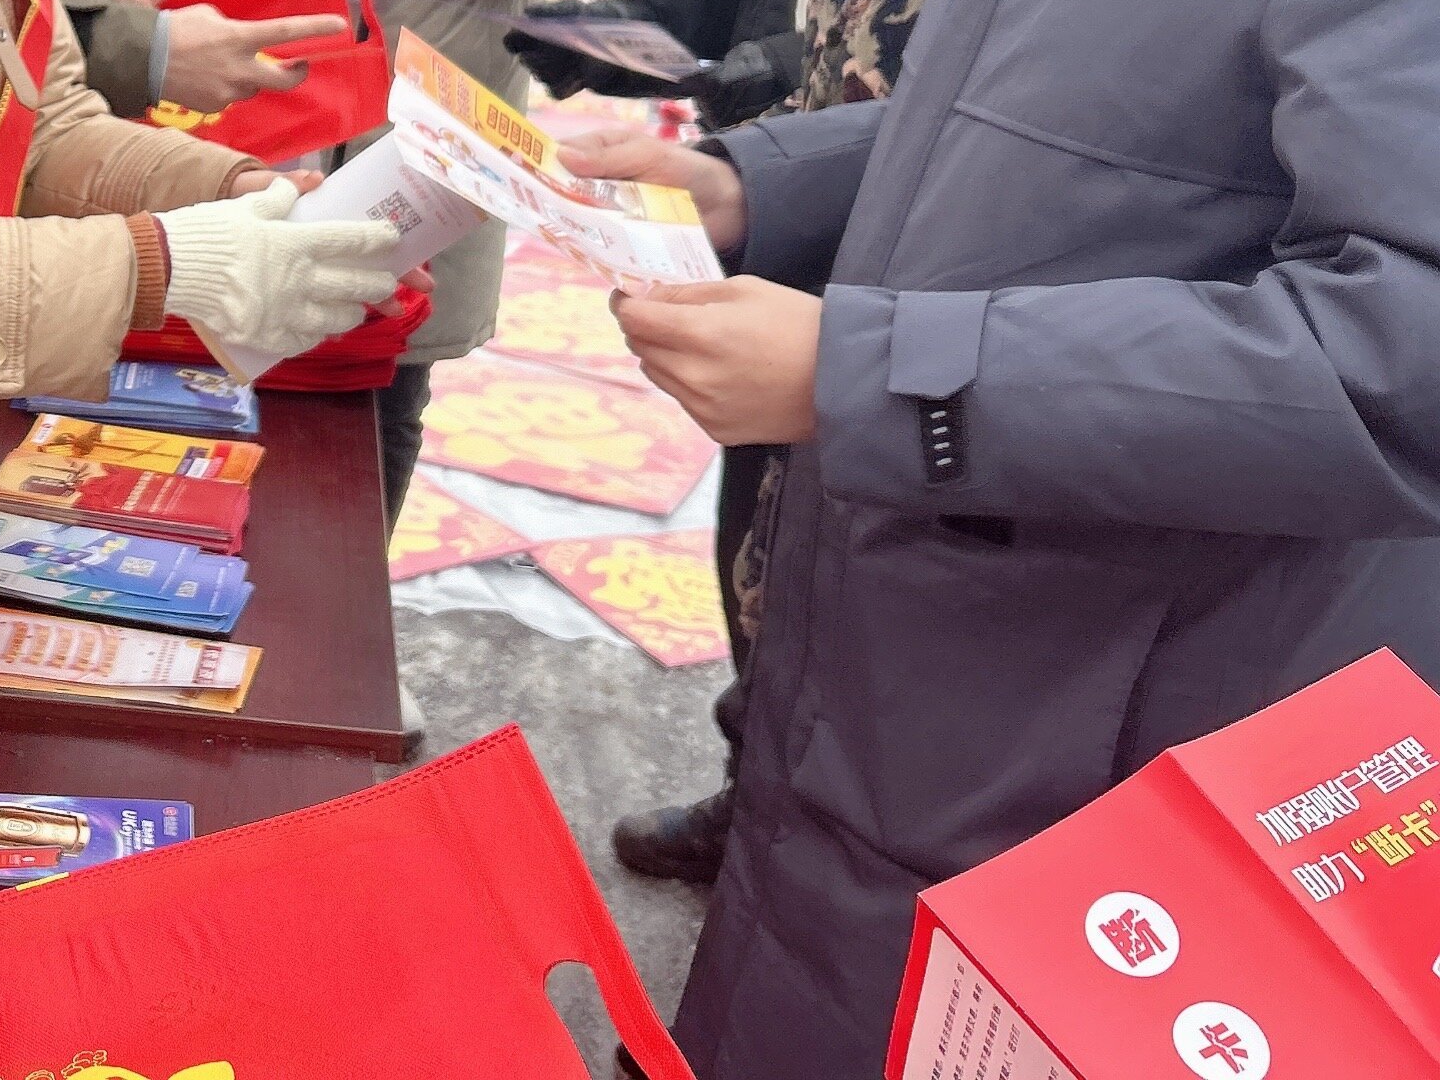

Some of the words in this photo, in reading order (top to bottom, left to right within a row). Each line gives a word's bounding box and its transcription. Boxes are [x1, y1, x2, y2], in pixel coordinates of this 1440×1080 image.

[1255, 735, 1440, 847] 加强账户管理
[1097, 907, 1168, 969] 断
[1198, 1021, 1250, 1075] 卡
